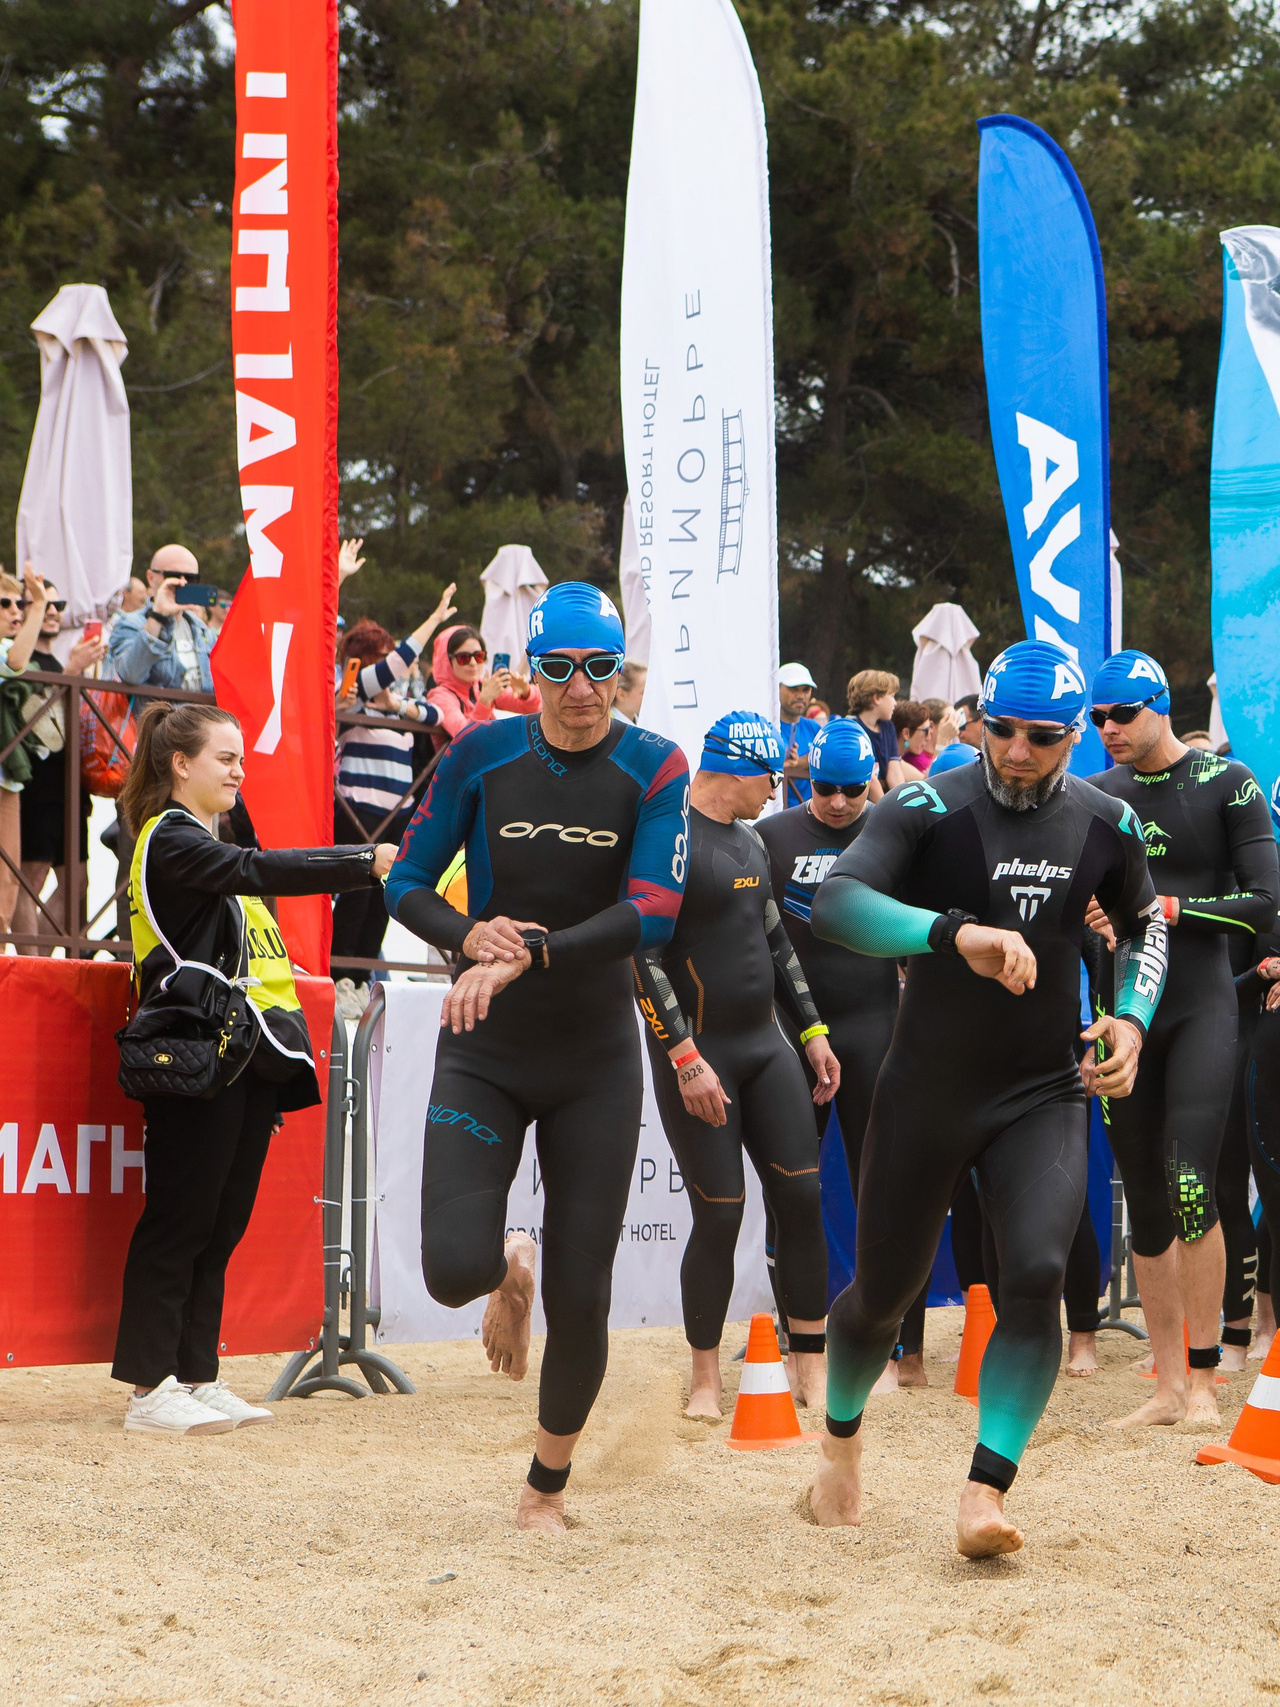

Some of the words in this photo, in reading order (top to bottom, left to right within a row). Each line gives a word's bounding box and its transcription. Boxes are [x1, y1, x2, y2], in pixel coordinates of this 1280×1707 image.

[729, 722, 763, 738] IRON
[727, 738, 781, 761] STAR
[1132, 771, 1171, 786] sailfish
[499, 821, 619, 847] orca
[991, 857, 1073, 883] phelps
[733, 876, 760, 890] 2XU
[639, 997, 670, 1040] 2XU
[680, 1064, 705, 1086] 3228
[630, 1223, 677, 1242] HOTEL
